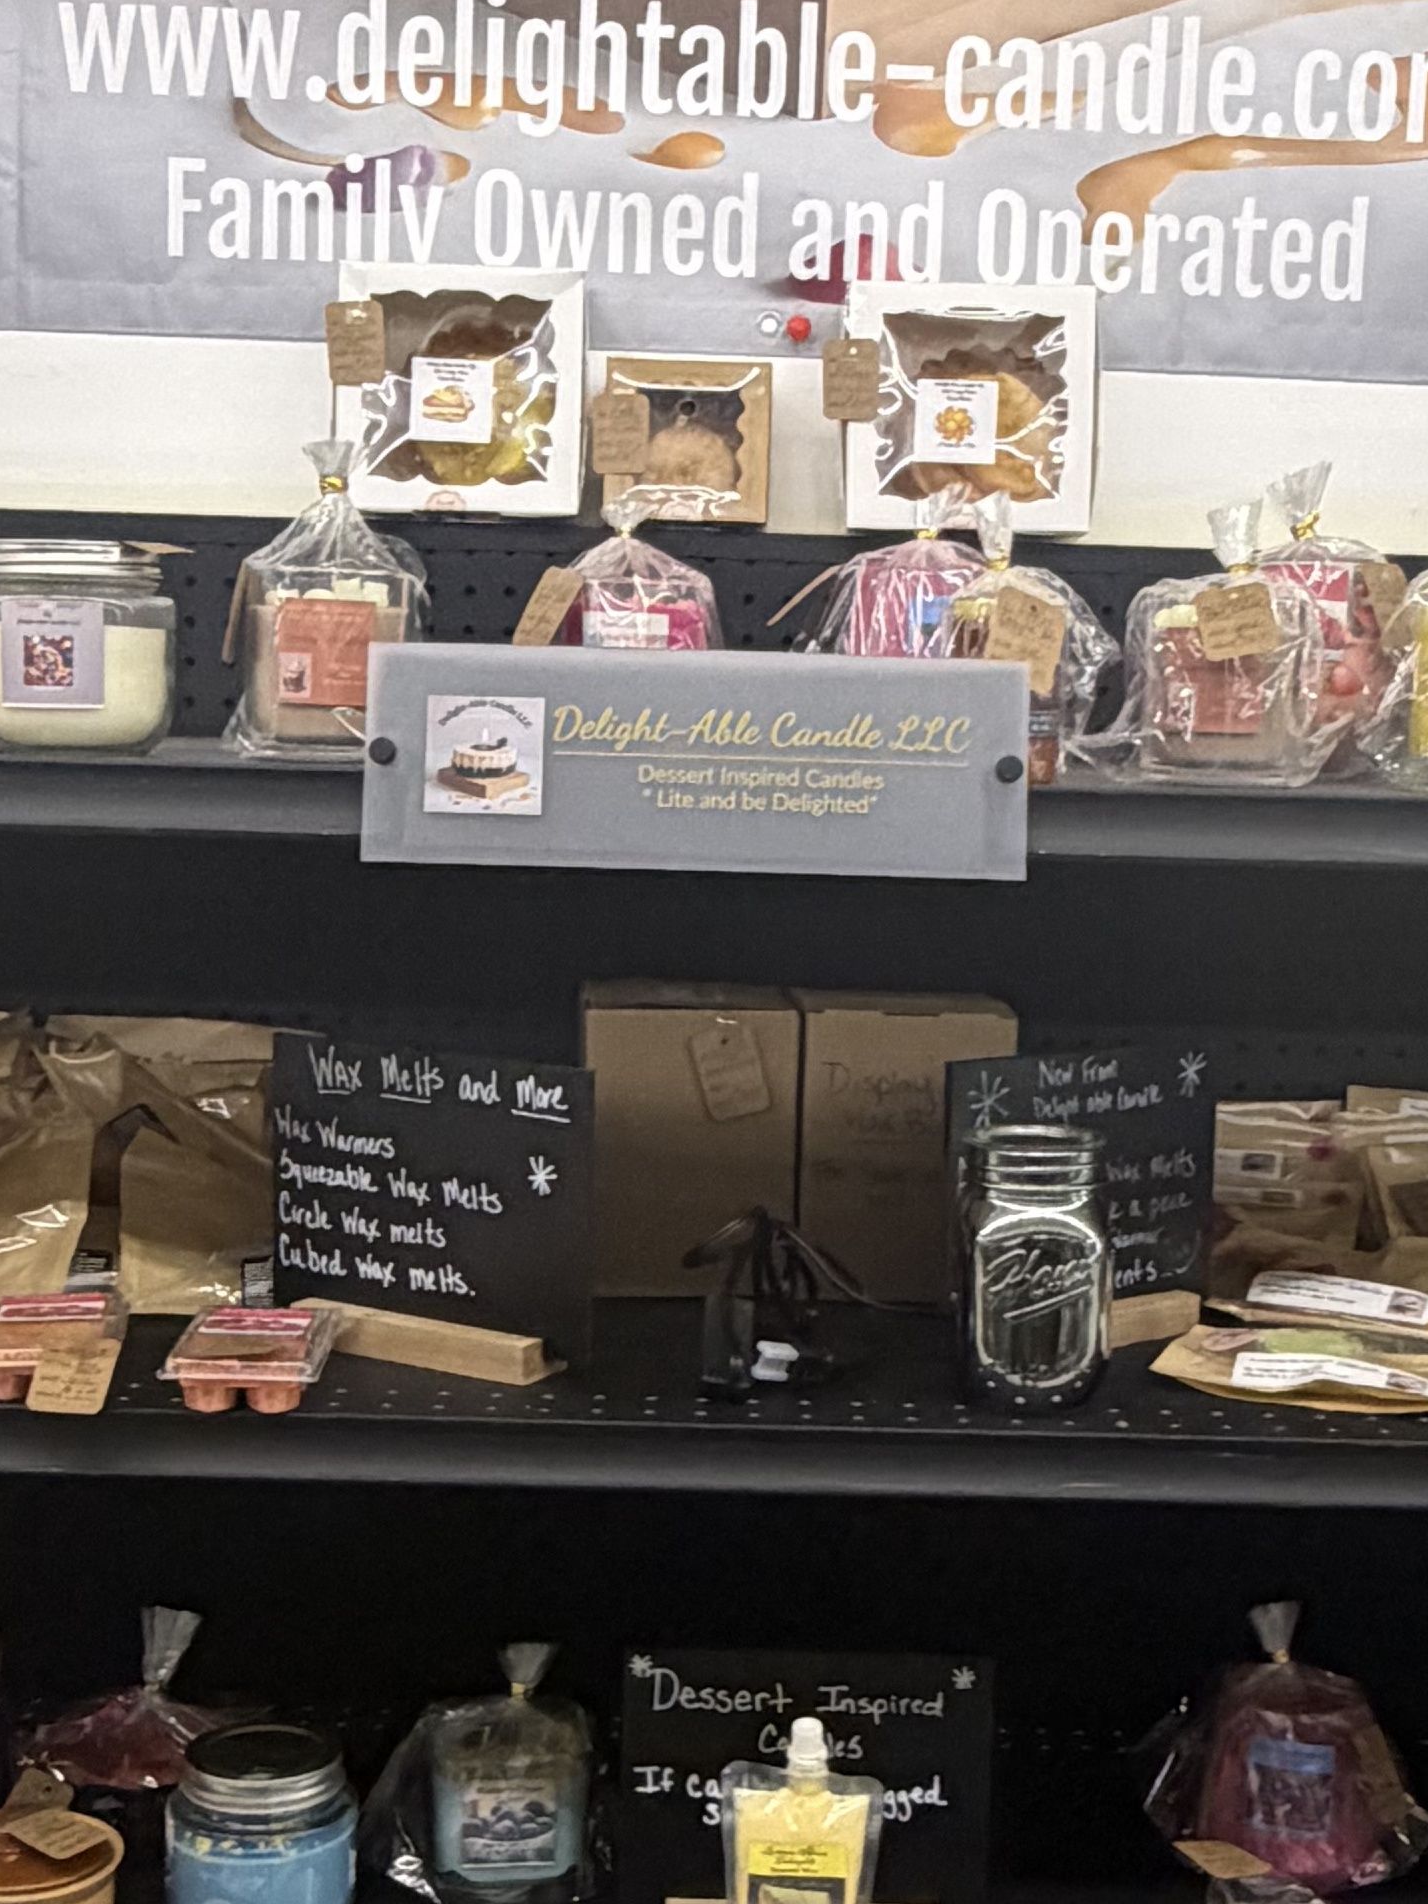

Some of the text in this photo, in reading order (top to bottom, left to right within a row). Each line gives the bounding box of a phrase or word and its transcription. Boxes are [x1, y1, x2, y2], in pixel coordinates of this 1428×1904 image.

[166, 156, 1367, 302] Family Owned and Operated
[552, 704, 972, 754] Delight-Able Candle LLC
[638, 763, 884, 791] Dessert Inspired Candles
[701, 791, 736, 810] and
[739, 791, 768, 810] be
[381, 1054, 444, 1094] Melts
[459, 1070, 501, 1104] and
[517, 1075, 569, 1110] More
[316, 1116, 395, 1159] Warmers
[387, 1168, 430, 1206] Wax
[442, 1177, 503, 1213] Melts
[341, 1207, 381, 1243] Wax
[278, 1233, 346, 1276] Cubed
[355, 1254, 396, 1287] Wax
[651, 1667, 944, 1725] Dessert Inspired
[634, 1766, 673, 1794] If
